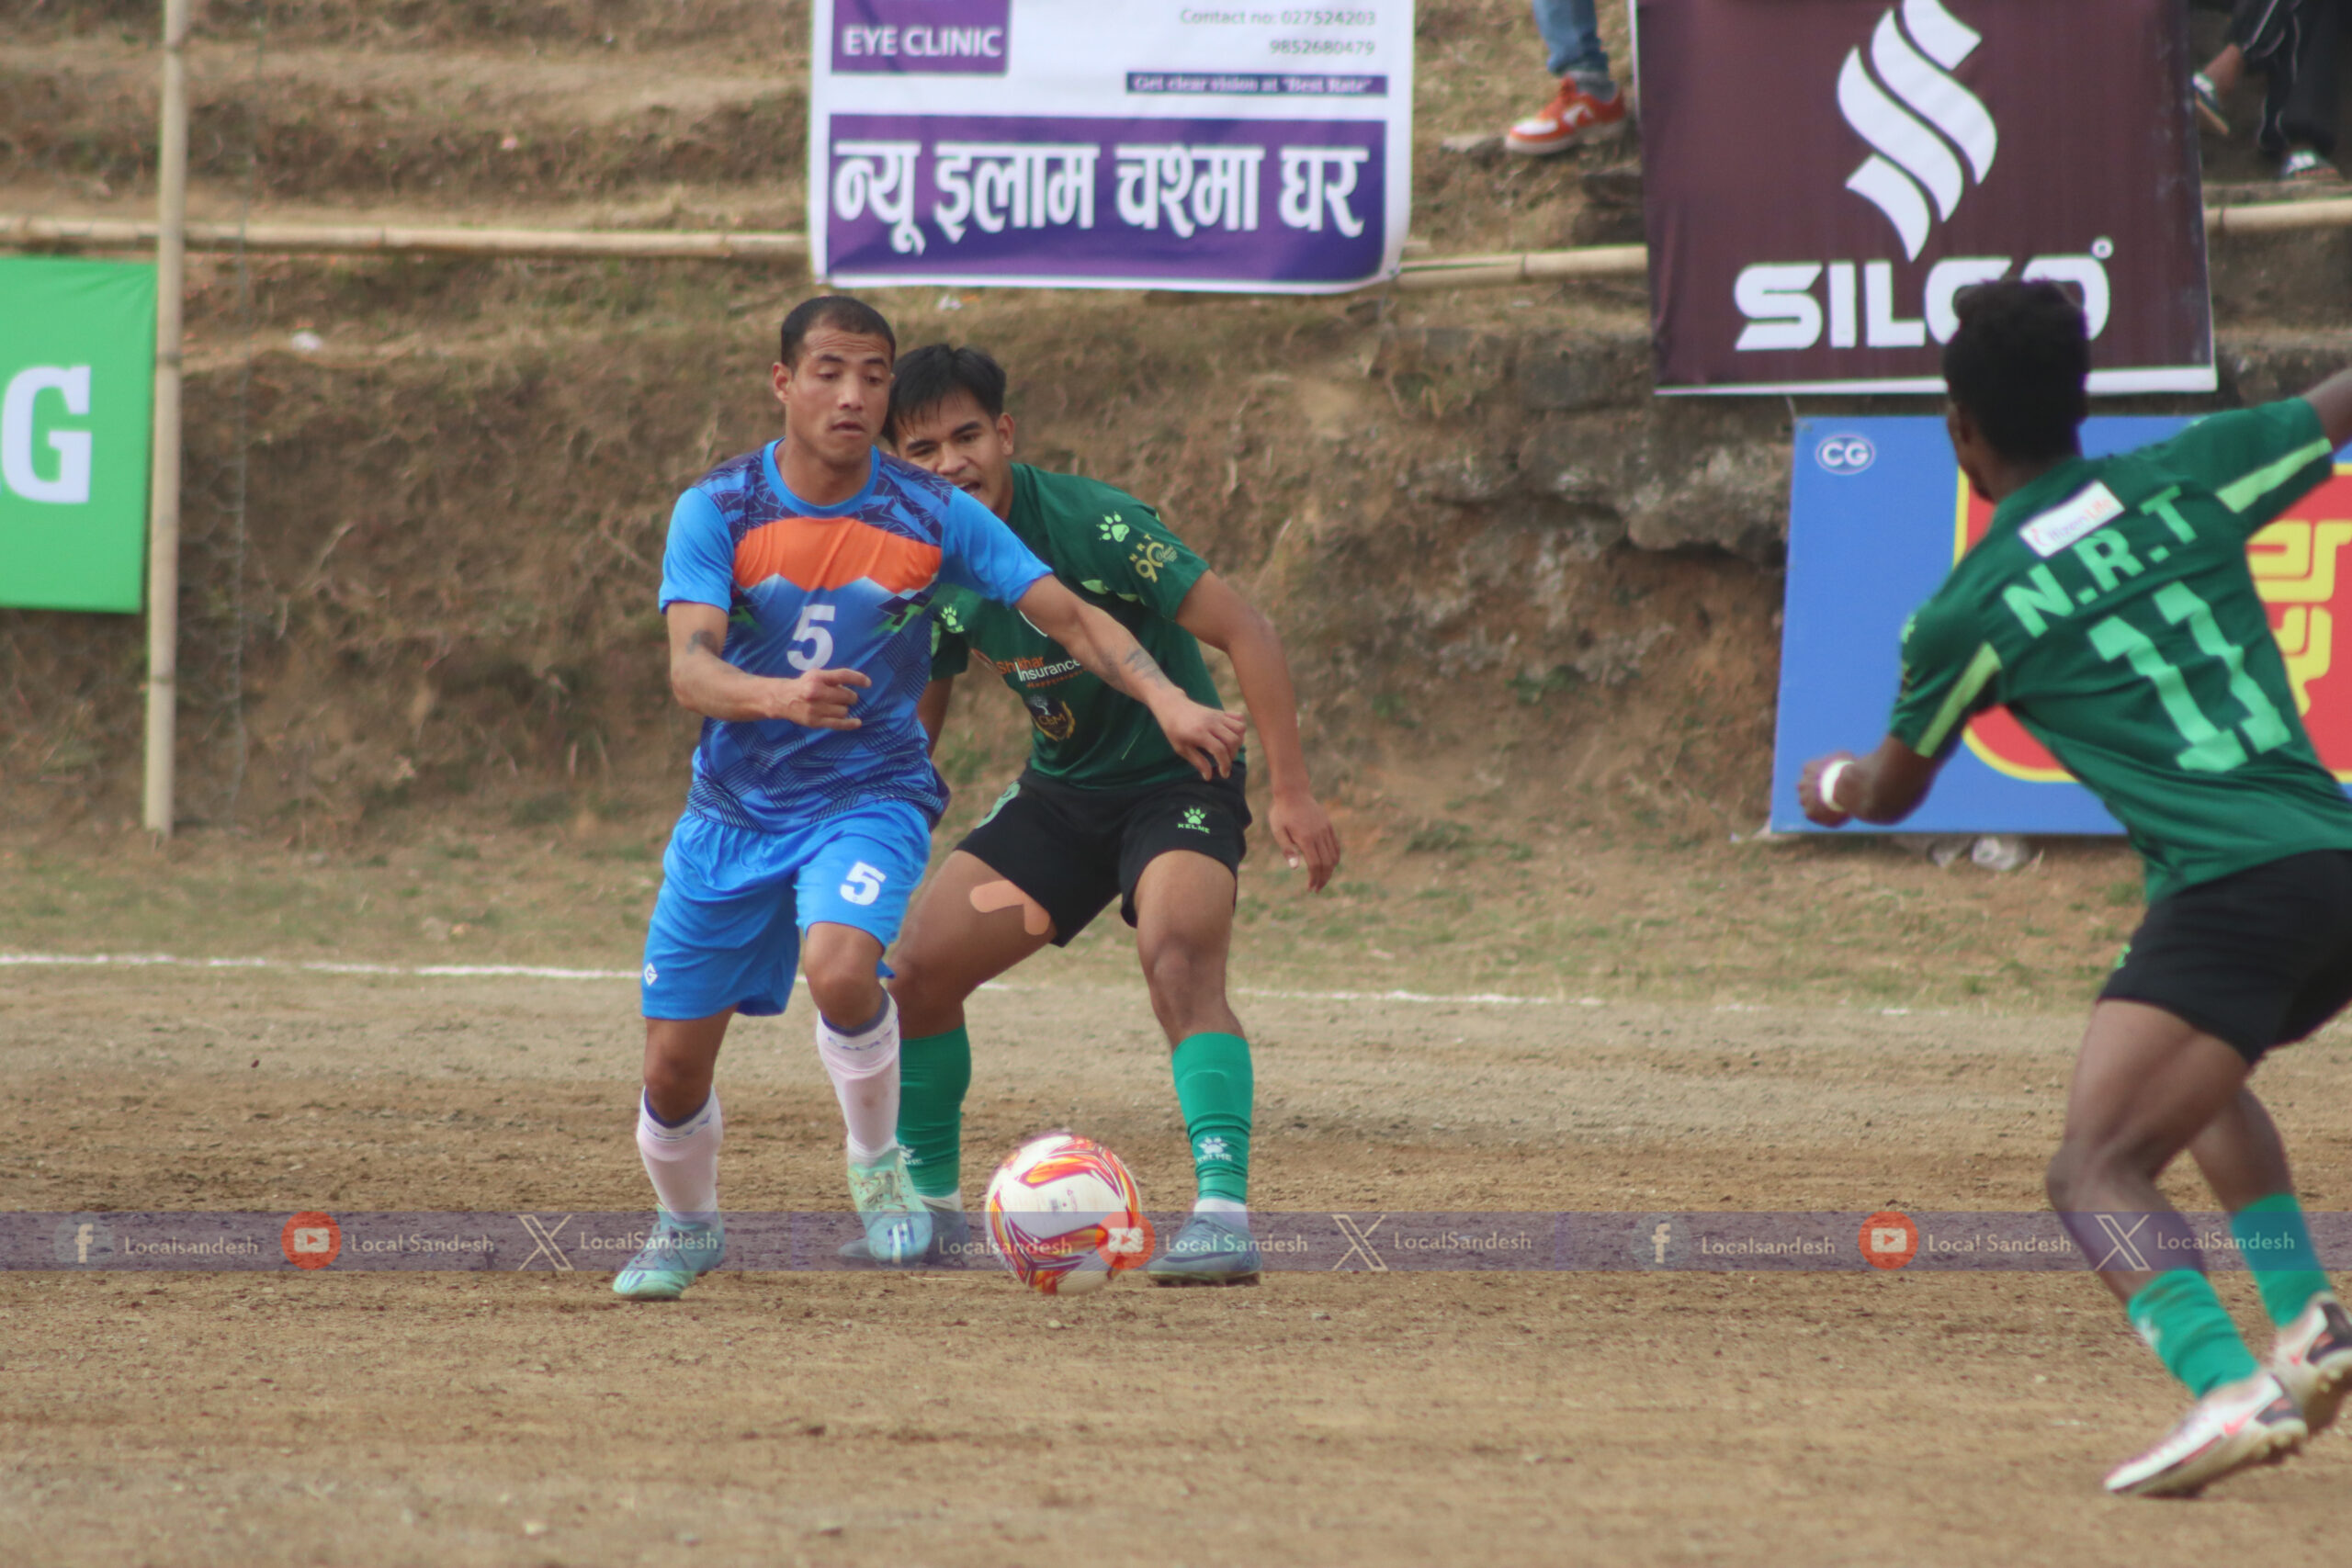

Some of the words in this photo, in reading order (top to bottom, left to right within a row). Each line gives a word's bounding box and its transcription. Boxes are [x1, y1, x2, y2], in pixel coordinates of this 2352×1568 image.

[1180, 8, 1245, 25] Contact
[1250, 12, 1277, 25] no:
[1280, 10, 1375, 26] 027524203
[843, 28, 898, 56] EYE
[902, 28, 1001, 57] CLINIC
[833, 142, 925, 254] न्यू
[934, 143, 1100, 243] इलाम
[1114, 144, 1264, 238] चश्मा
[1279, 146, 1369, 238] घर
[1822, 441, 1871, 467] CG
[786, 604, 835, 671] 5
[2087, 581, 2291, 773] 11
[839, 862, 887, 906] 5
